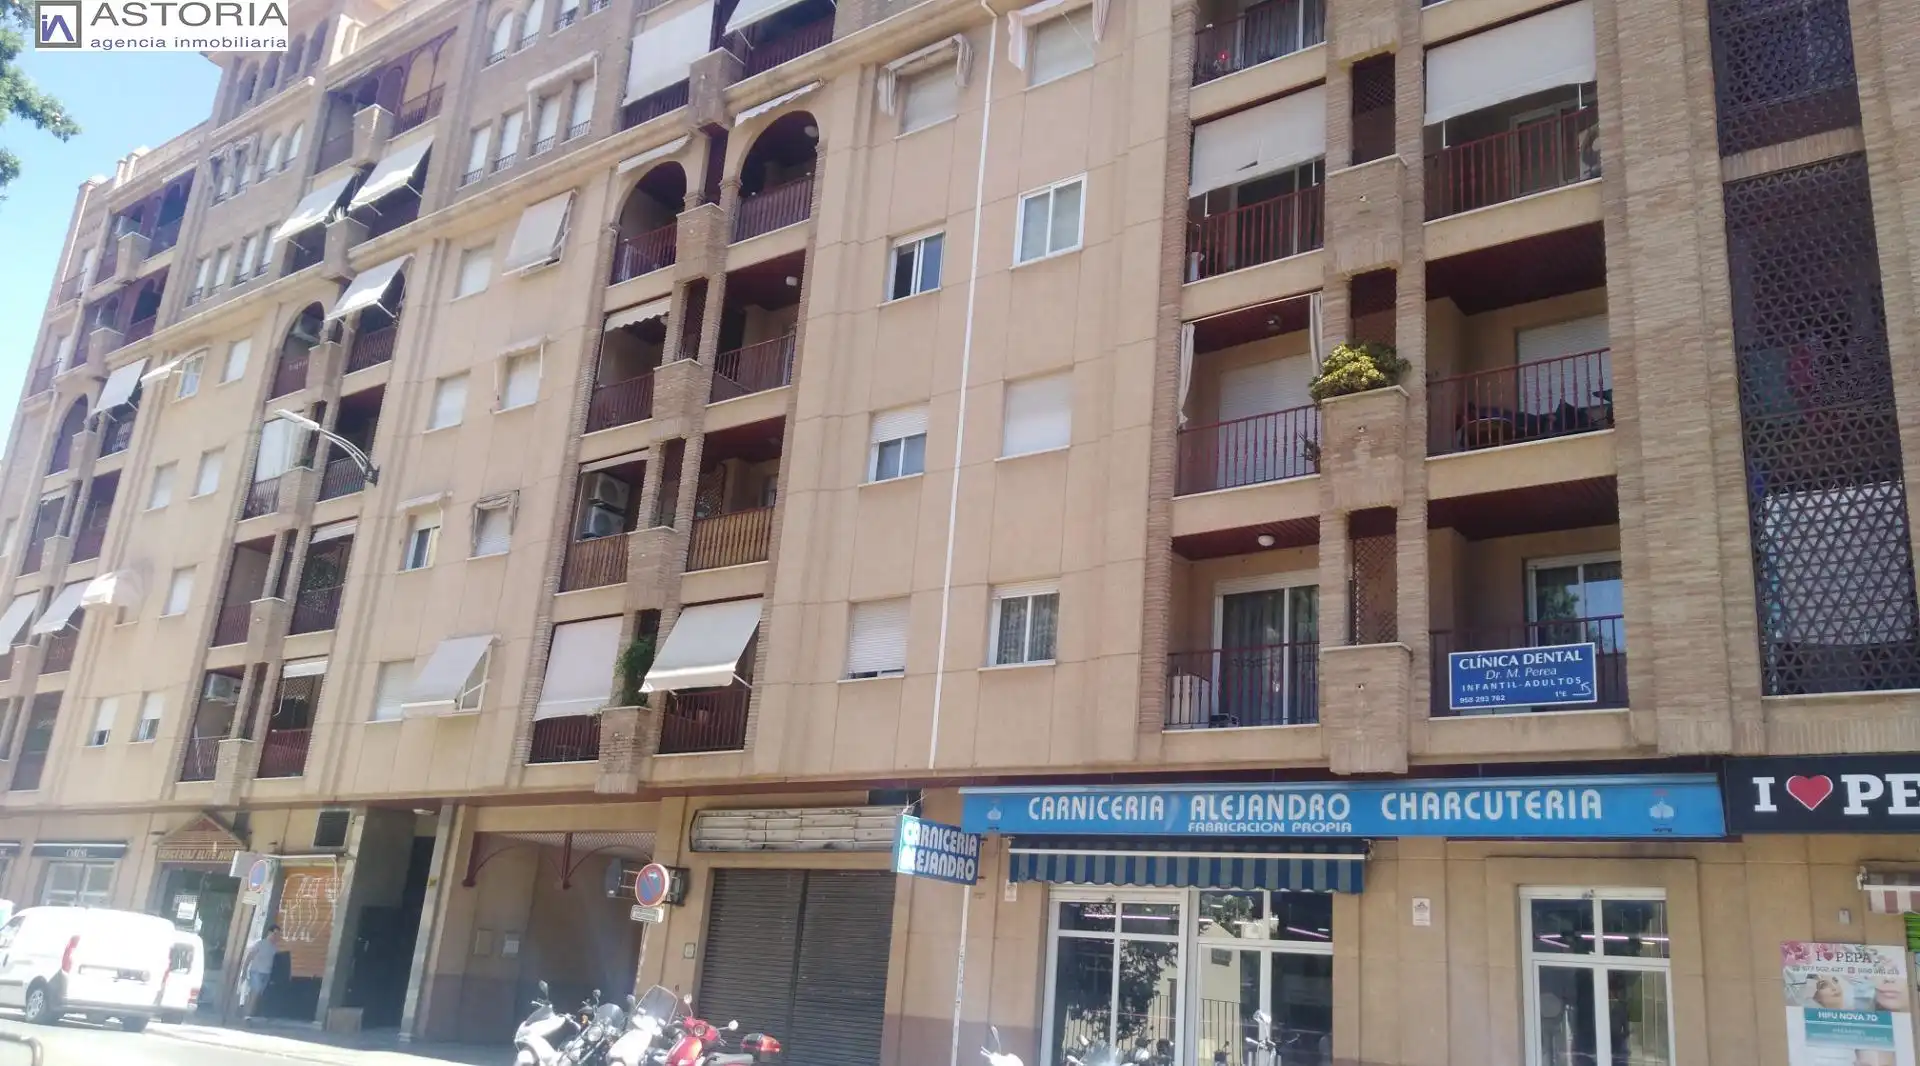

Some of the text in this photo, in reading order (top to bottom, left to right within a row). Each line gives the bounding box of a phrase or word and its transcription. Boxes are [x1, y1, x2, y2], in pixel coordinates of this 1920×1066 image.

[1459, 649, 1583, 670] CLÍNICA DENTAL
[1485, 667, 1557, 680] Dr. M. Perea
[1752, 776, 1778, 812] I
[1028, 788, 1603, 821] CARNICERIA ALEJANDRO CHARCUTERIA
[1188, 822, 1352, 833] FABRICACION PROPIA
[1836, 951, 1872, 963] PEPA
[1840, 1013, 1864, 1021] NOVA
